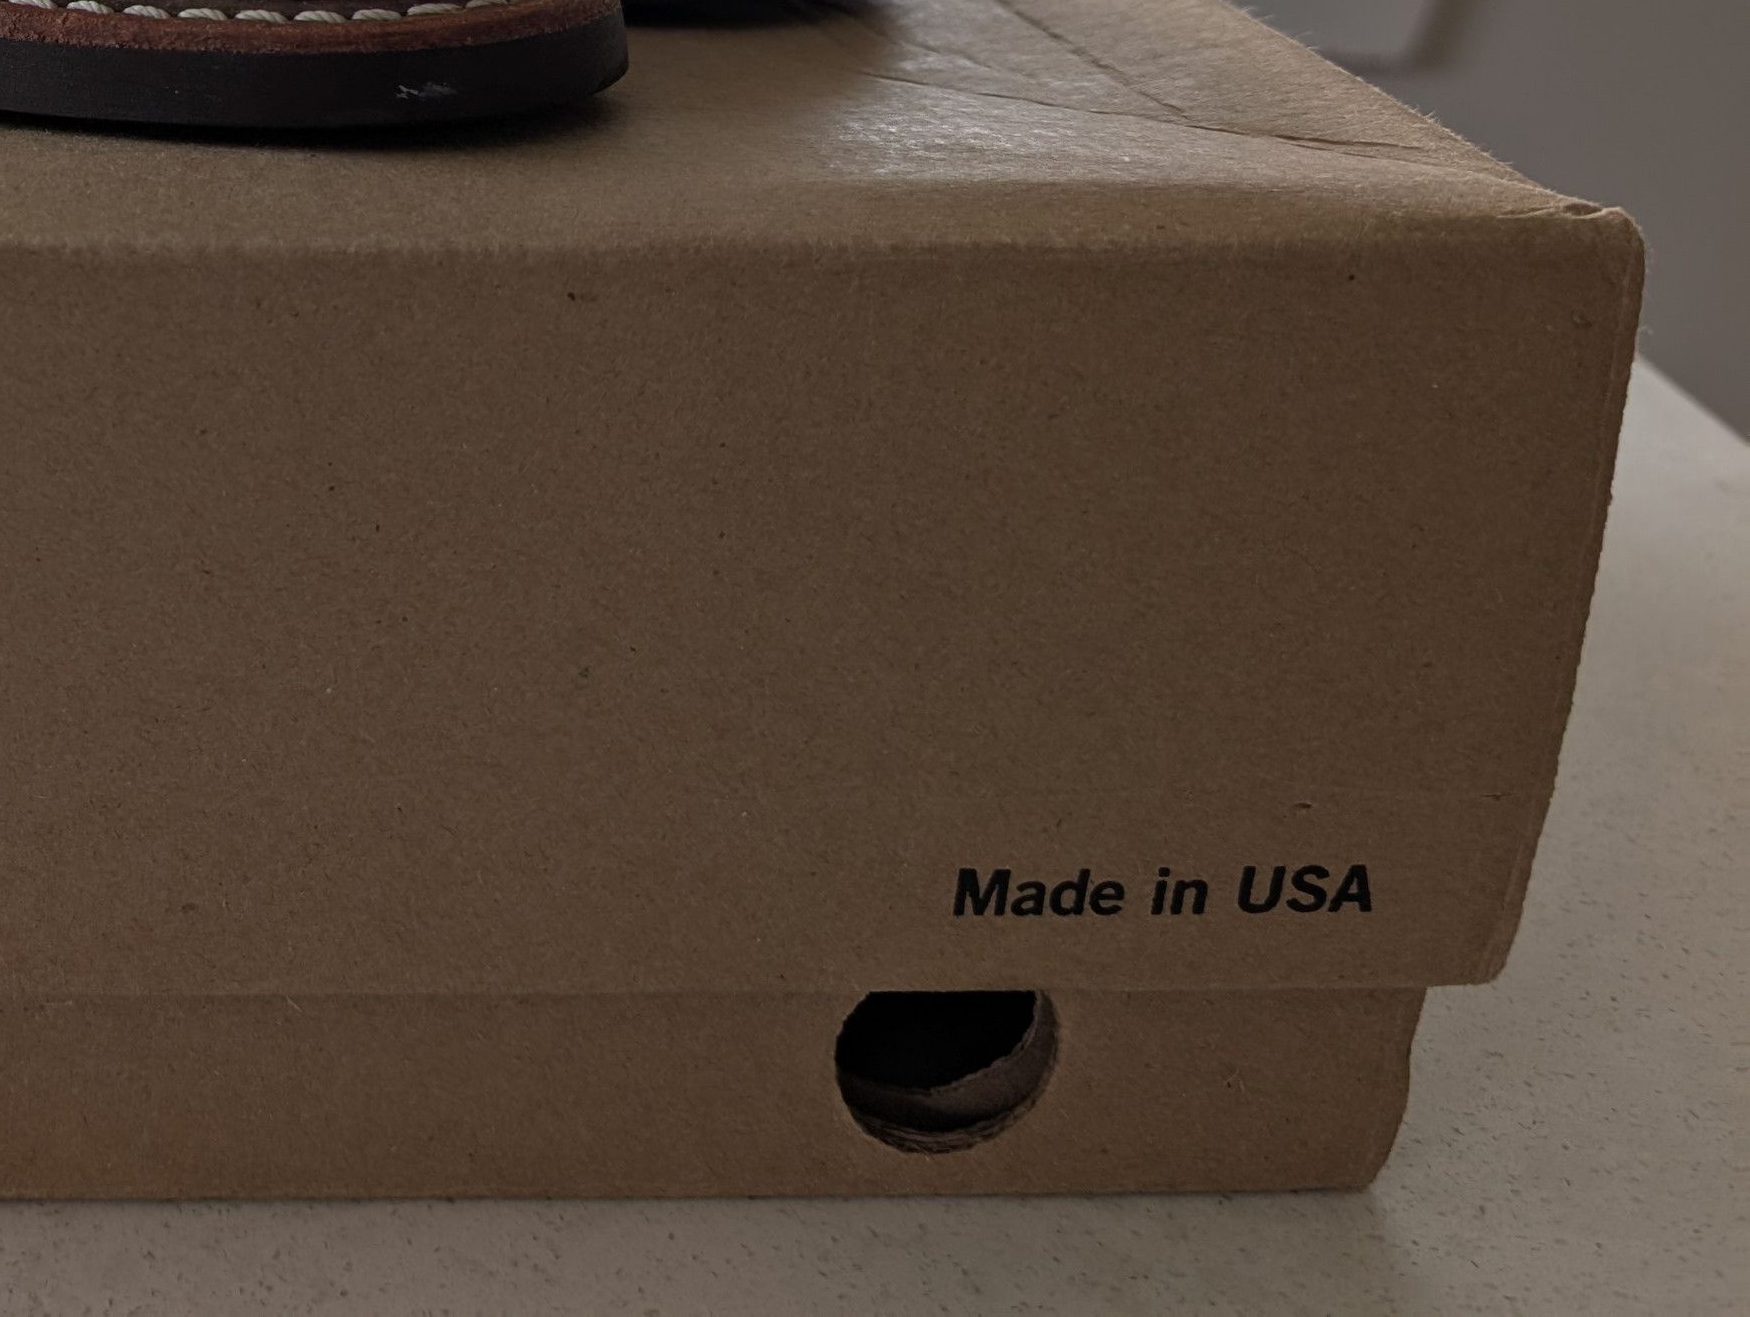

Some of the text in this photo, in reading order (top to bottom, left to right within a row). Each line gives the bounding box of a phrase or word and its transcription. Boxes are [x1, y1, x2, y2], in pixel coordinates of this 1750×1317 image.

[953, 864, 1373, 916] Made in USA
